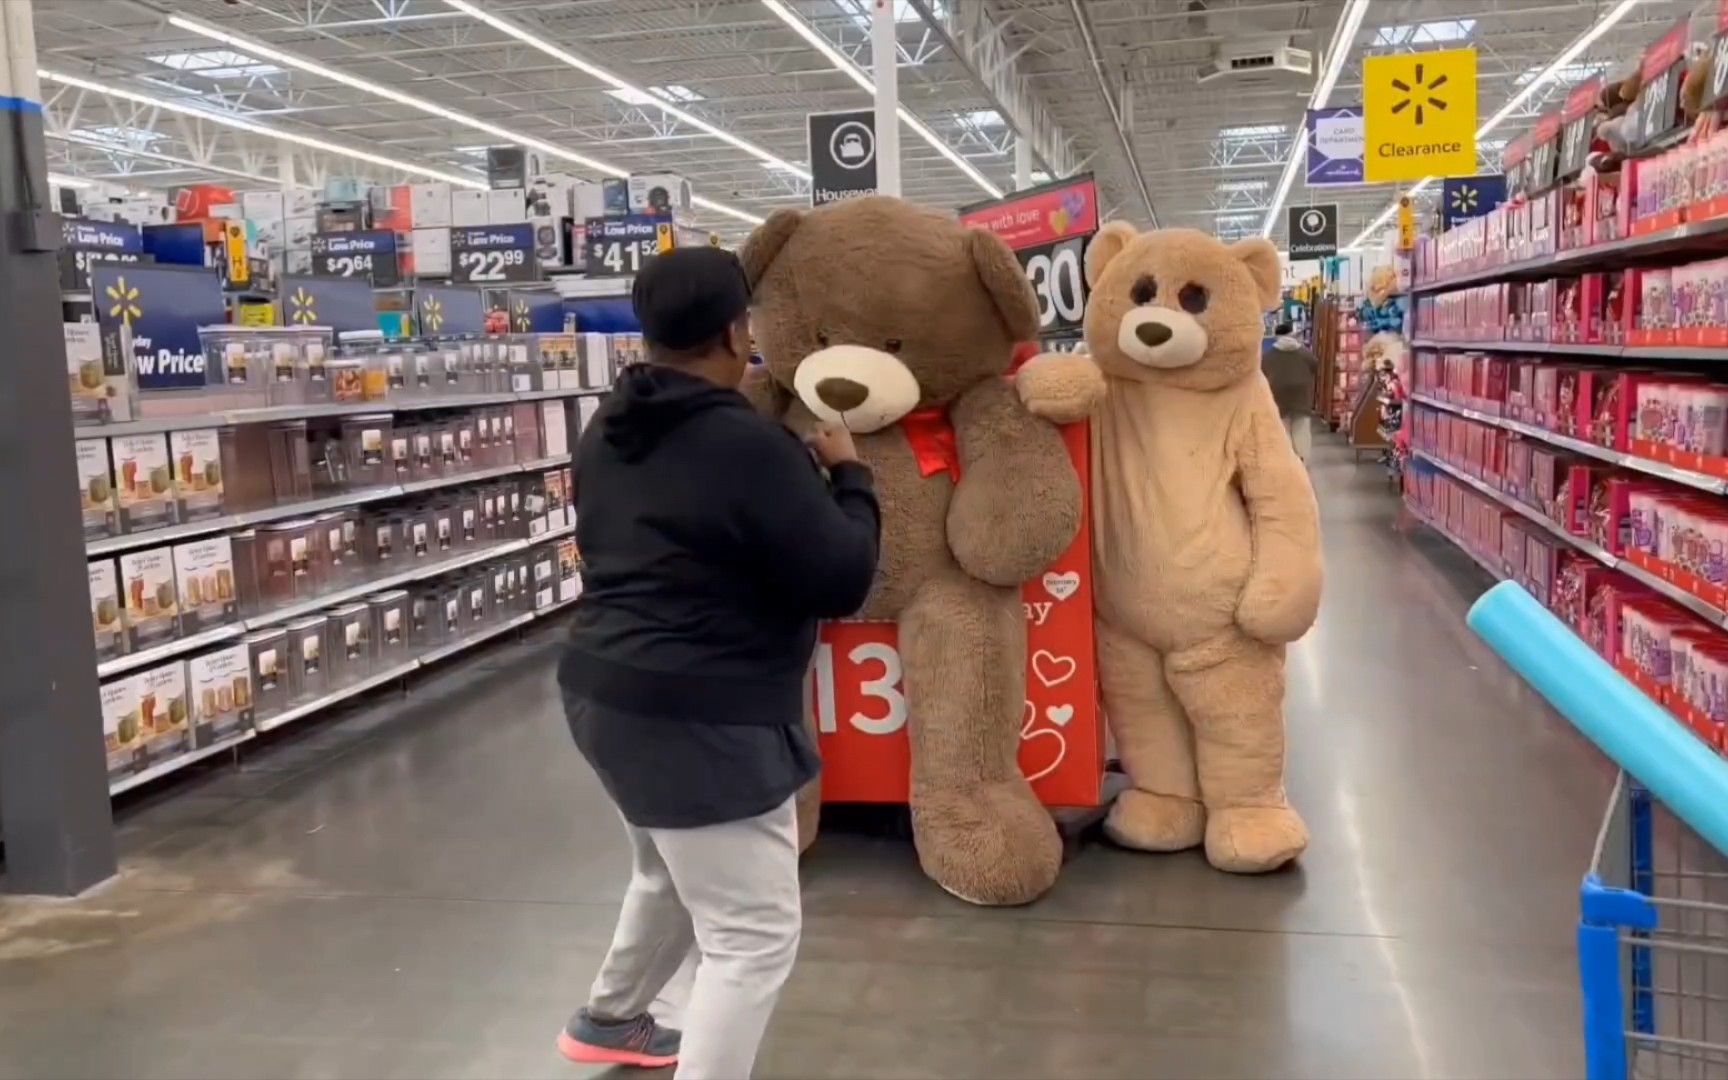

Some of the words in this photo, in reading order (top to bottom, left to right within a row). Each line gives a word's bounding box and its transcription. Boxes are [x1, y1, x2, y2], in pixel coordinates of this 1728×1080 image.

[1379, 141, 1461, 159] Clearance
[991, 212, 1013, 231] with
[1016, 208, 1040, 225] love
[604, 225, 625, 236] Low
[628, 224, 653, 234] Price
[78, 231, 98, 244] Low
[99, 232, 124, 246] Price
[328, 240, 348, 251] Low
[350, 239, 375, 250] Price
[467, 235, 487, 245] Low
[489, 234, 514, 244] Price
[1290, 242, 1336, 254] Celebrations
[158, 348, 204, 374] Price
